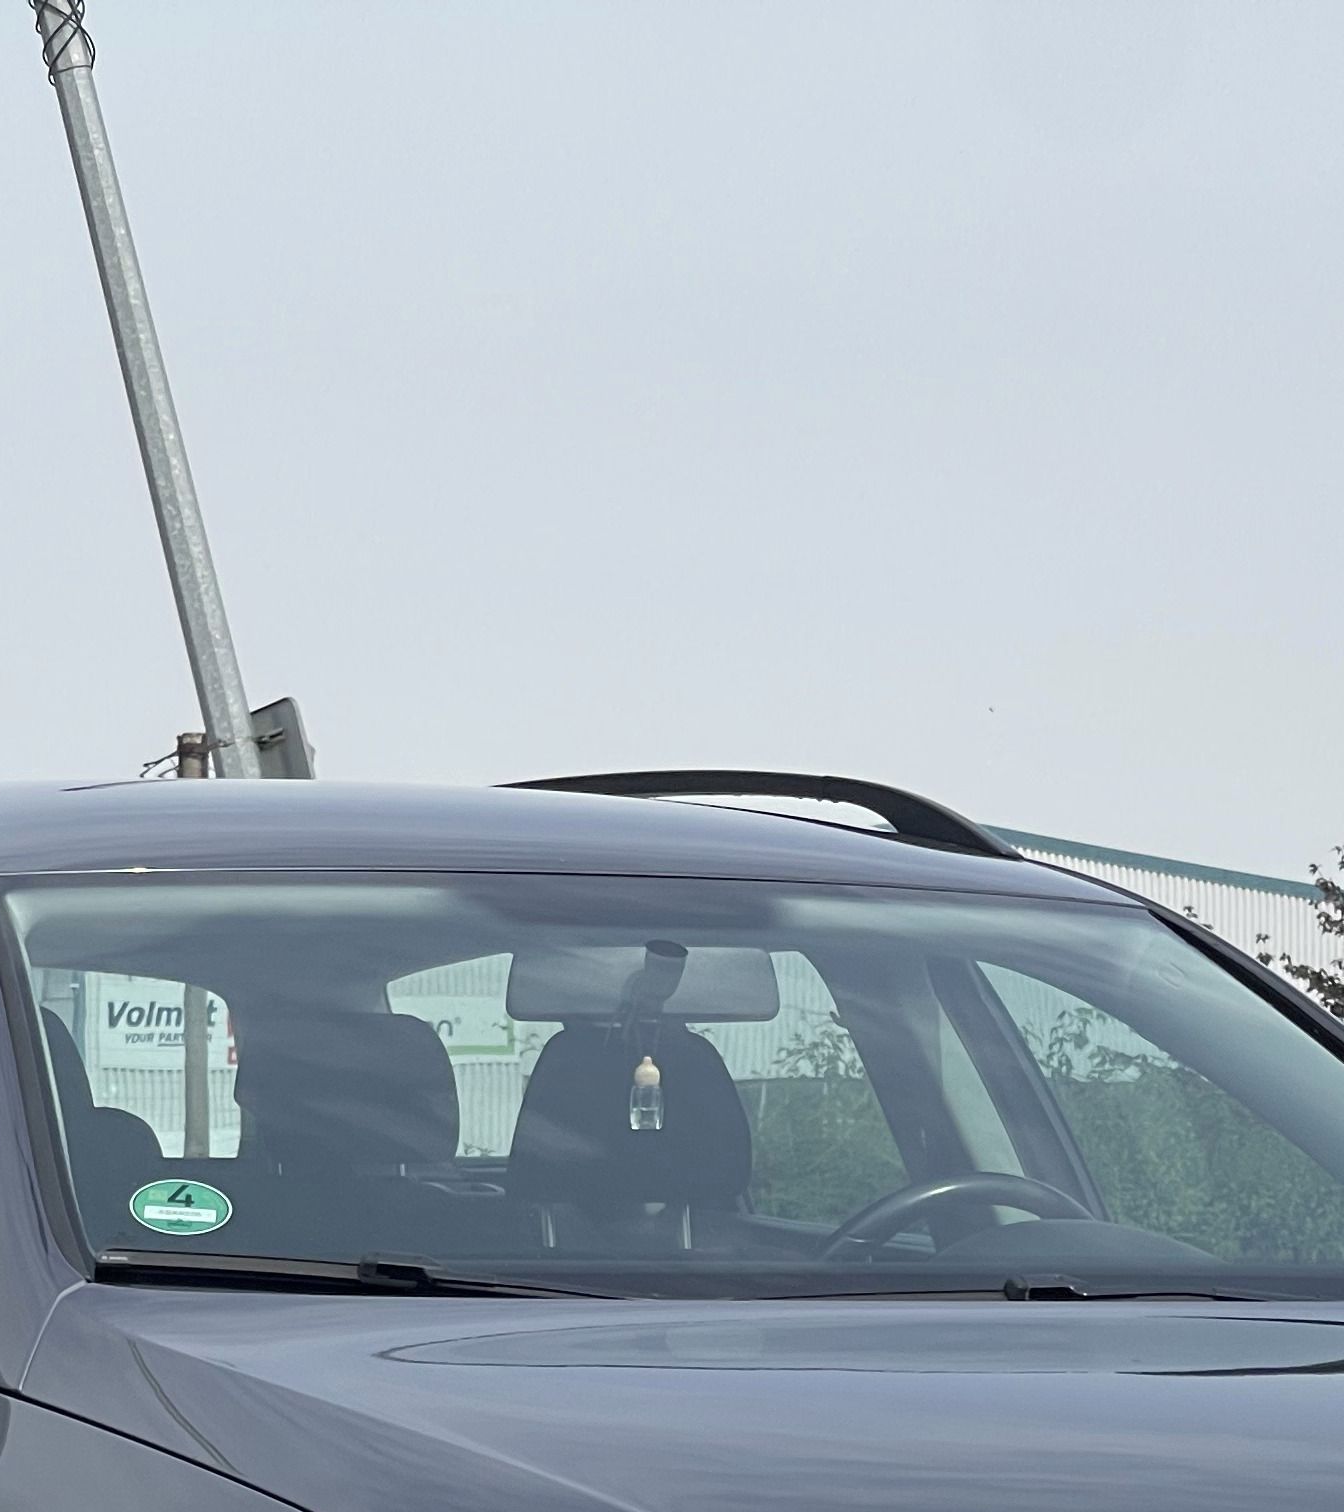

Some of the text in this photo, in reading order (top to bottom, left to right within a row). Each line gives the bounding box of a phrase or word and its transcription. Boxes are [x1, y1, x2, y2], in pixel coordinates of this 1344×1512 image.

[107, 1000, 218, 1029] Volmt
[125, 1033, 154, 1044] YOUR
[167, 1184, 195, 1208] 4
